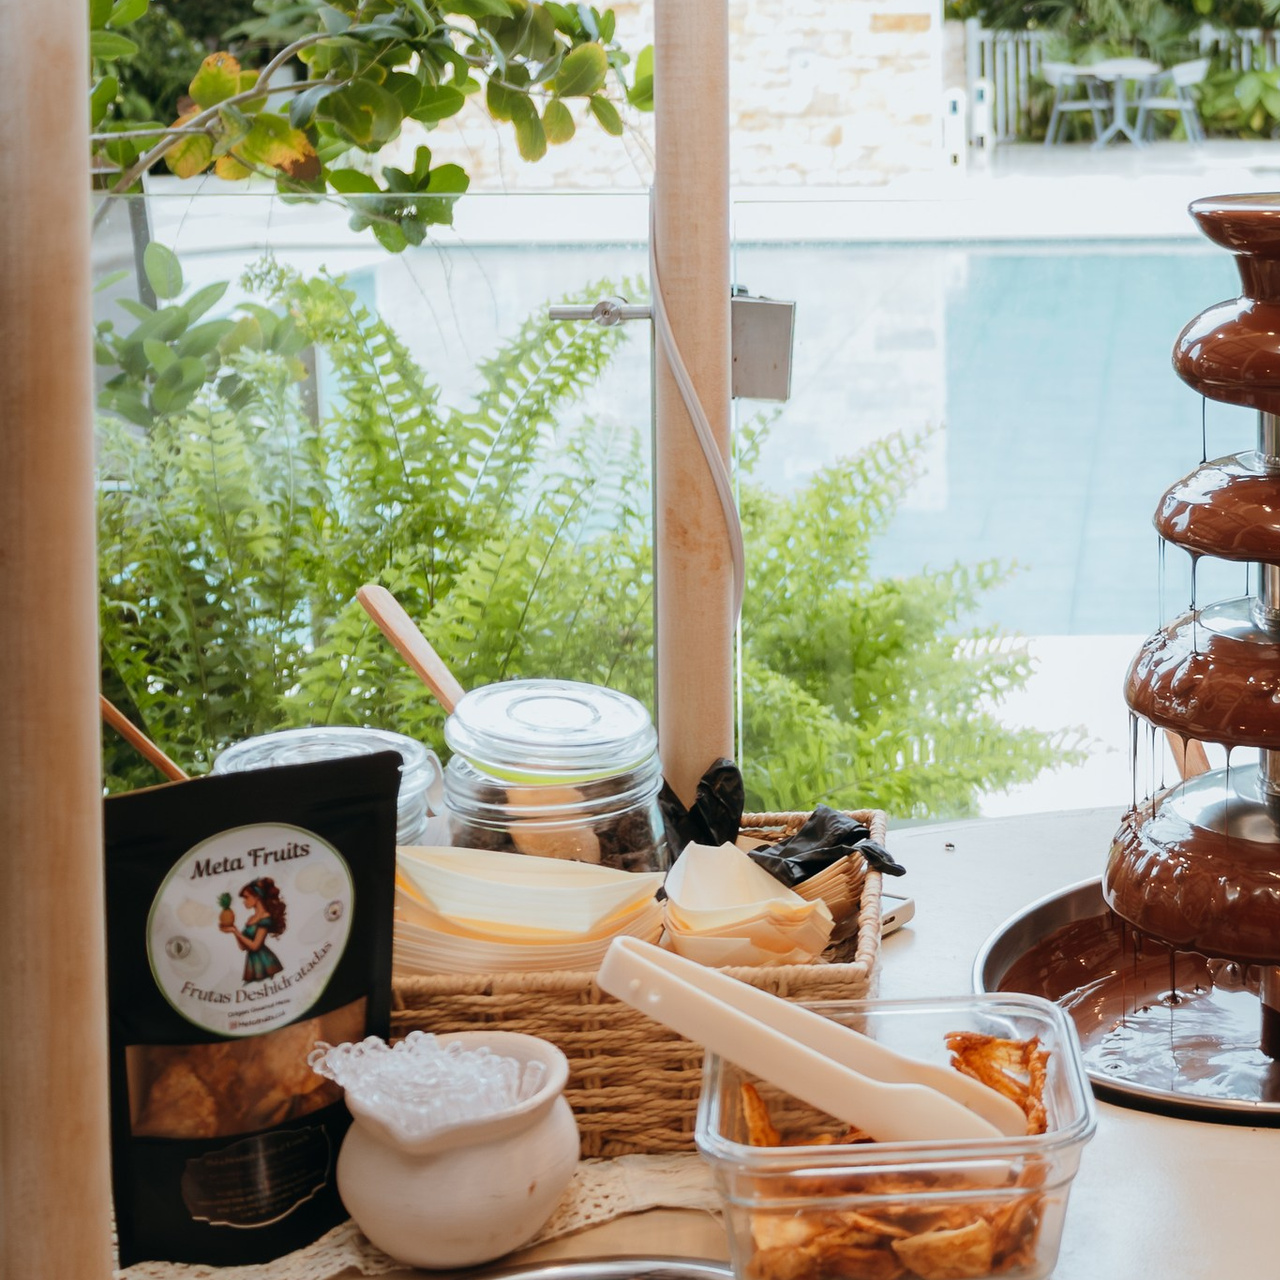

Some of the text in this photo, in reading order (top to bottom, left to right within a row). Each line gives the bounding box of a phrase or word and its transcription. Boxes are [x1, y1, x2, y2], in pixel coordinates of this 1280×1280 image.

[189, 842, 310, 880] Meta Fruits
[180, 941, 333, 1004] Frutas Deshidratadas
